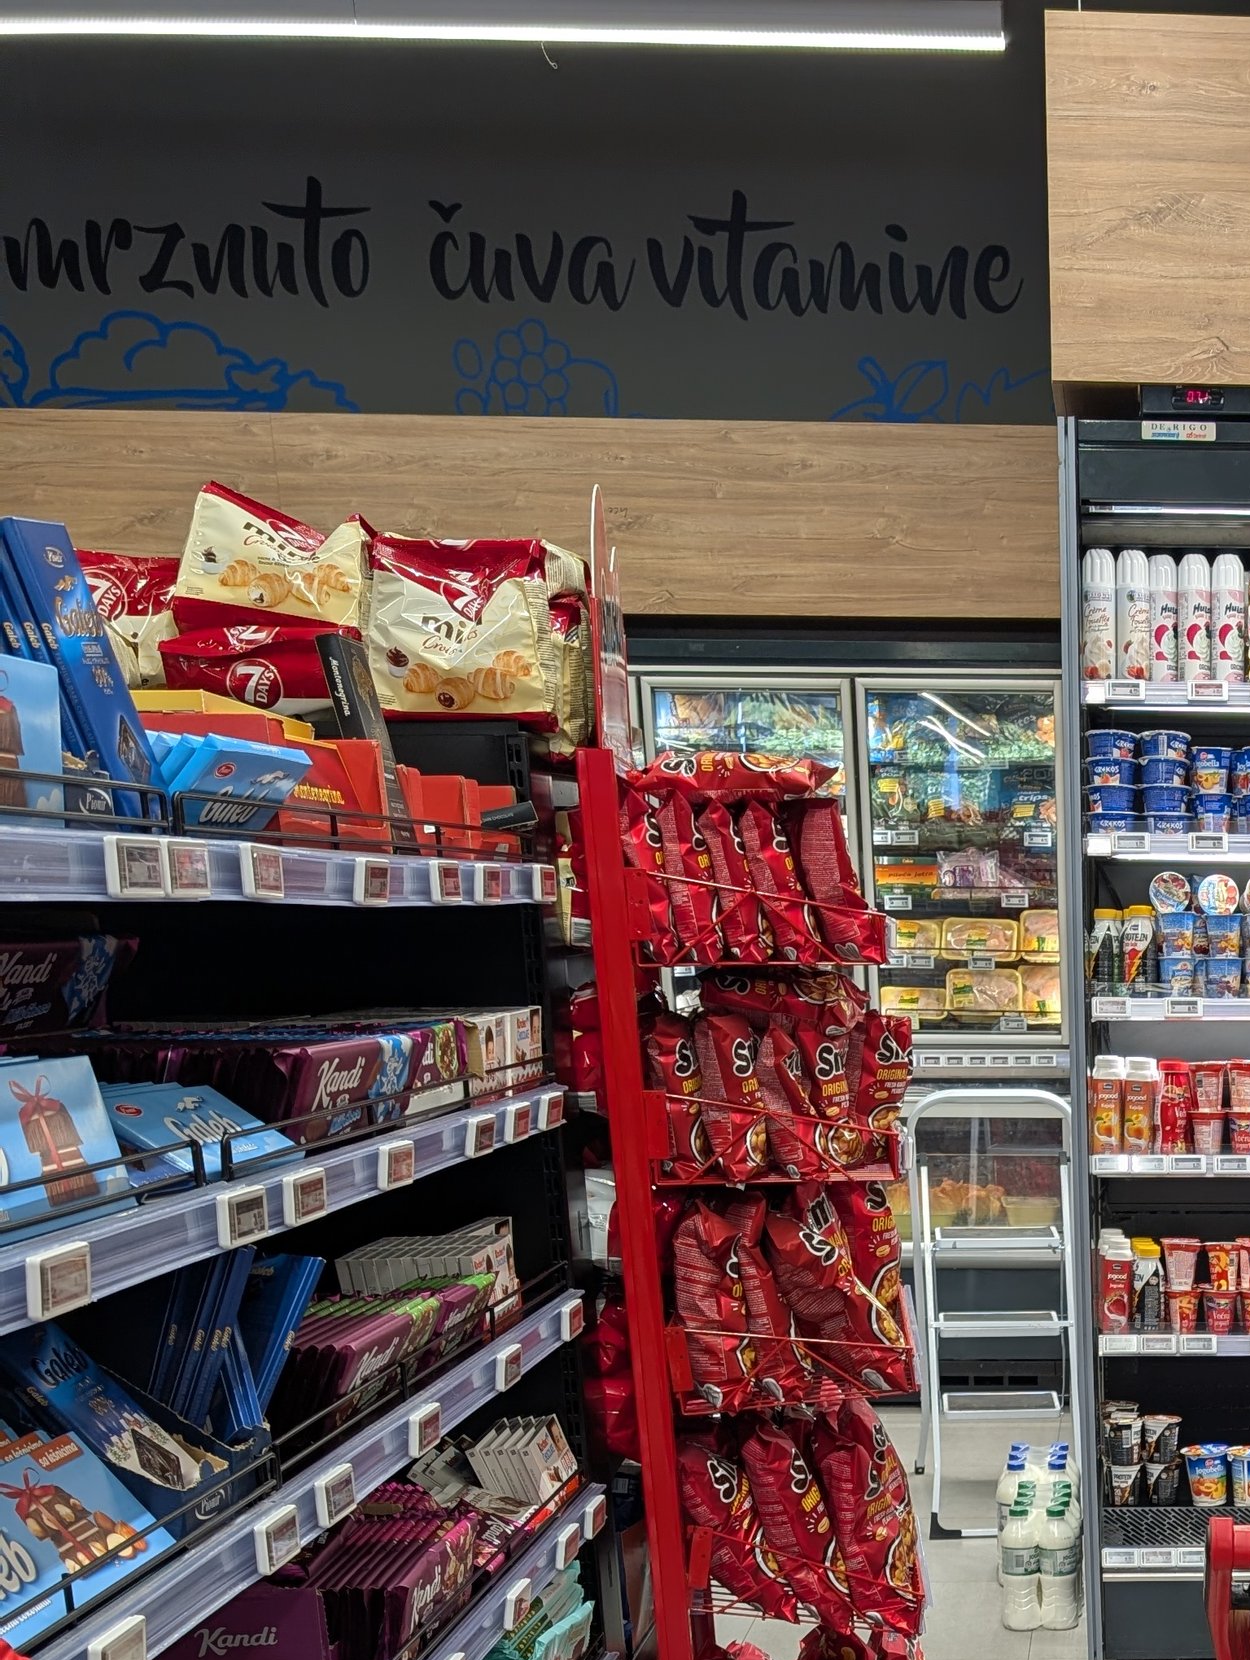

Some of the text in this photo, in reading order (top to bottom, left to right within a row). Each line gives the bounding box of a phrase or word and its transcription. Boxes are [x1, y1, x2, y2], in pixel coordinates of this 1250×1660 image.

[428, 201, 637, 311] čuva
[646, 189, 1027, 320] vitamine
[3, 621, 21, 649] Galeb
[24, 621, 40, 649] Galeb
[41, 622, 59, 650] Galeb
[257, 668, 276, 704] DAYS
[330, 656, 351, 716] Montenegrina
[316, 1054, 365, 1109] Kandi
[1099, 1093, 1118, 1101] jogood
[164, 1110, 241, 1143] Galeb
[1107, 1272, 1127, 1281] jogood
[34, 1349, 88, 1389] Galeb
[355, 1336, 393, 1379] Kandi
[39, 1442, 78, 1467] sa lešnicima
[1195, 1464, 1227, 1476] Jogobella
[409, 1562, 442, 1627] Kandi
[196, 1626, 277, 1658] Kandi
